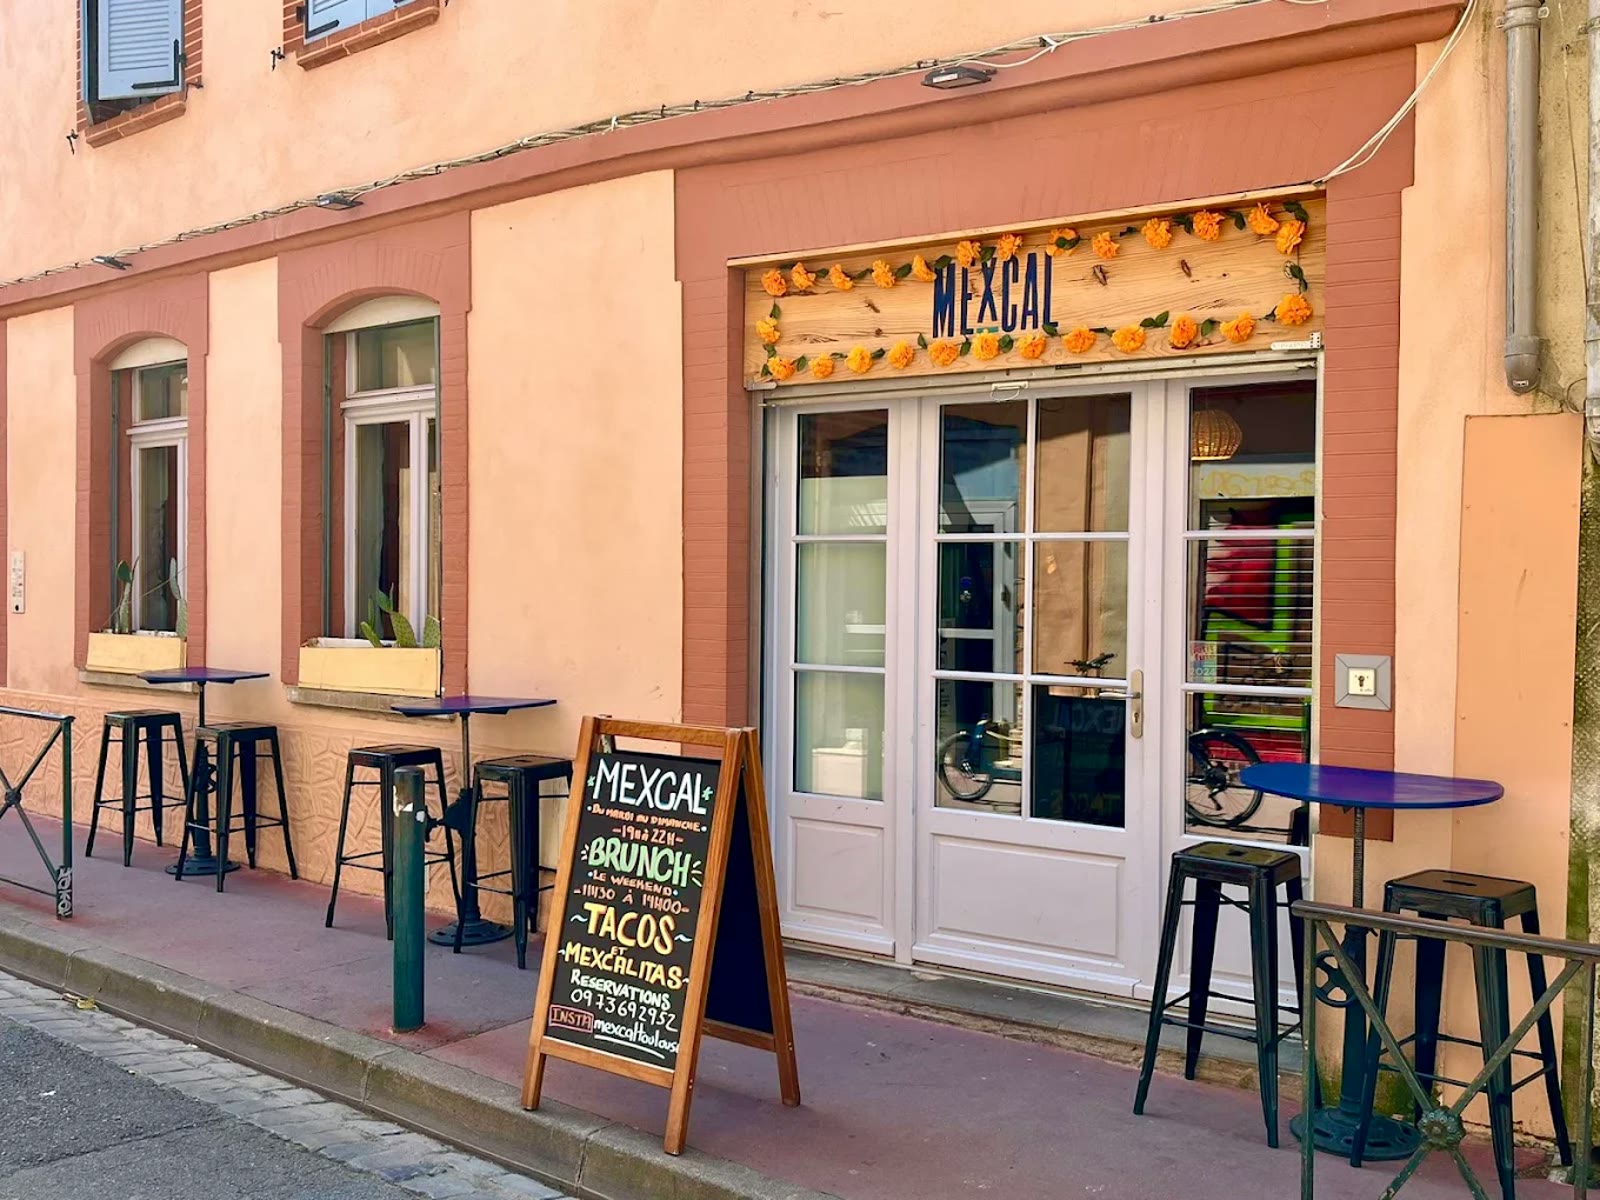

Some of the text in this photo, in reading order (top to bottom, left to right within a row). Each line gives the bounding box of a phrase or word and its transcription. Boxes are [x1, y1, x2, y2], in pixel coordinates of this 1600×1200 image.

[933, 252, 1058, 338] MEXCAL
[593, 758, 706, 815] MEXCAL
[650, 815, 701, 832] DIMANCHE
[588, 837, 692, 888] BRUNCH
[592, 869, 673, 897] LE WEEKEND
[583, 902, 675, 955] TACOS
[611, 946, 628, 956] ET
[564, 941, 683, 990] MEXCALITAS
[570, 969, 671, 1011] RESERVATIONS
[552, 1007, 592, 1030] INSTA
